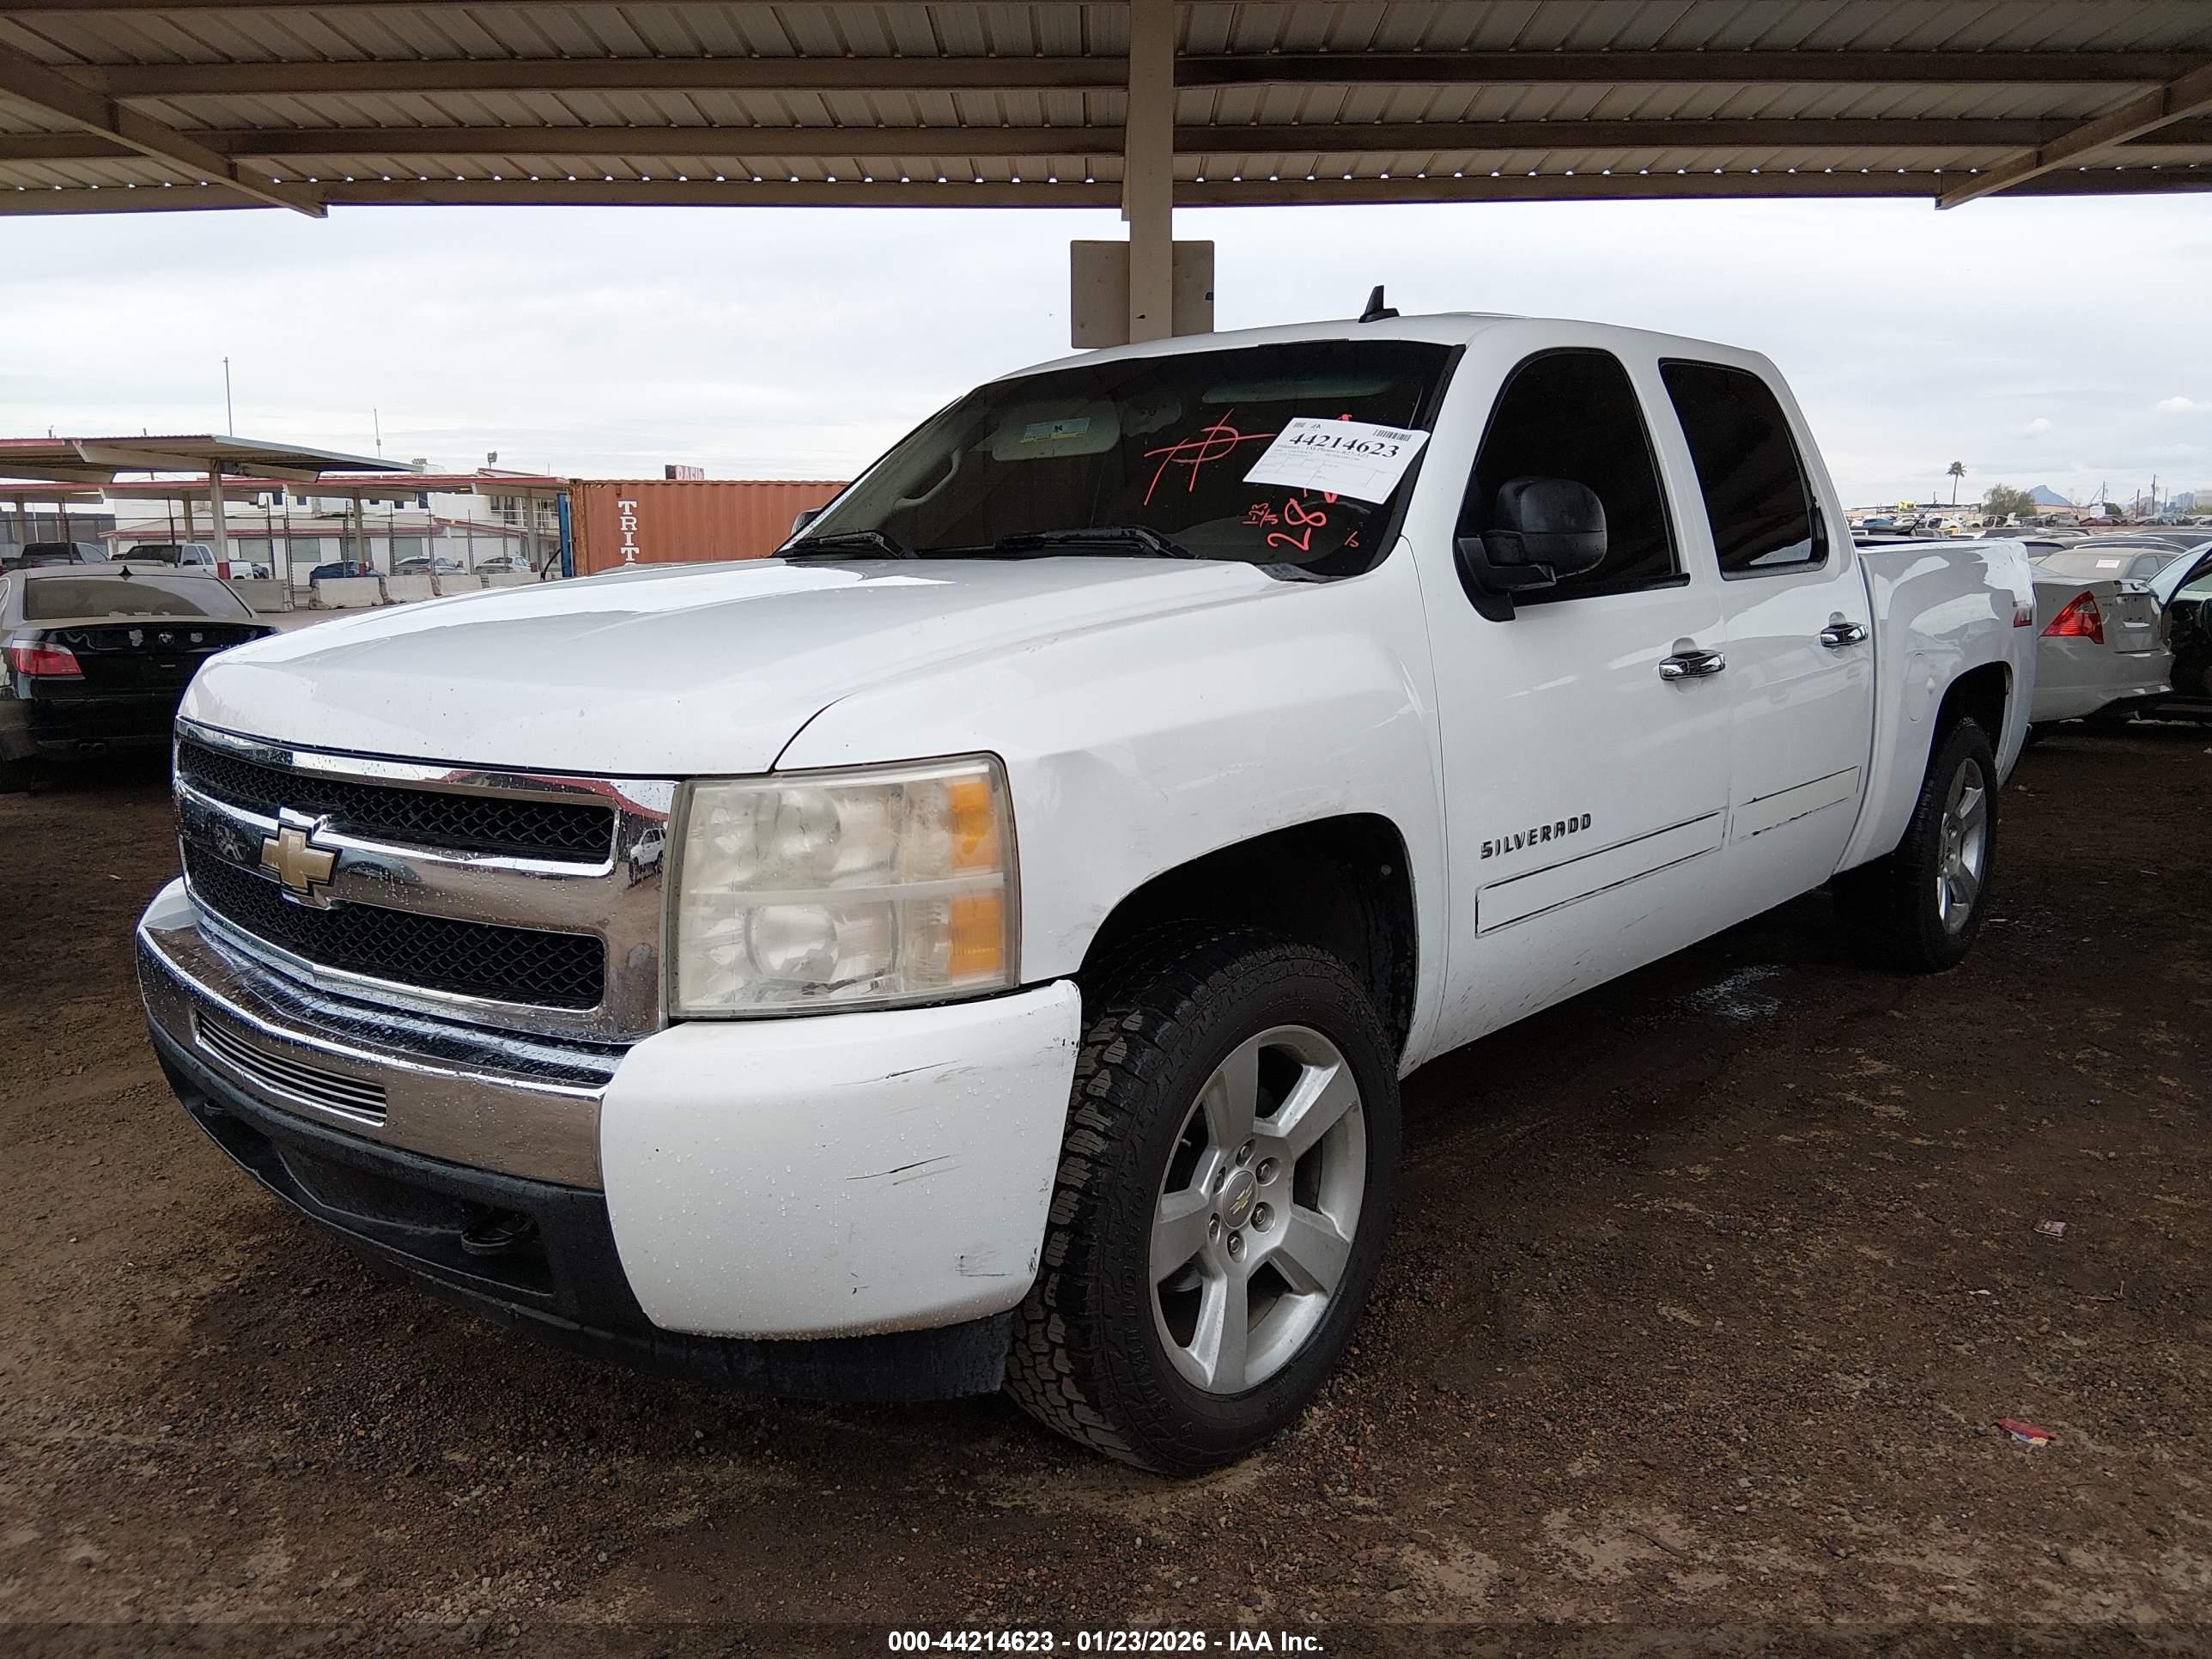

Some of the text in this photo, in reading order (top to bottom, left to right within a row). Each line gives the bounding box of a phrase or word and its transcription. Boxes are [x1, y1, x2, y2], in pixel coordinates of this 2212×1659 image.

[1289, 433, 1401, 459] 44214623
[617, 501, 640, 565] TRIT
[1480, 812, 1592, 860] SILVERADO
